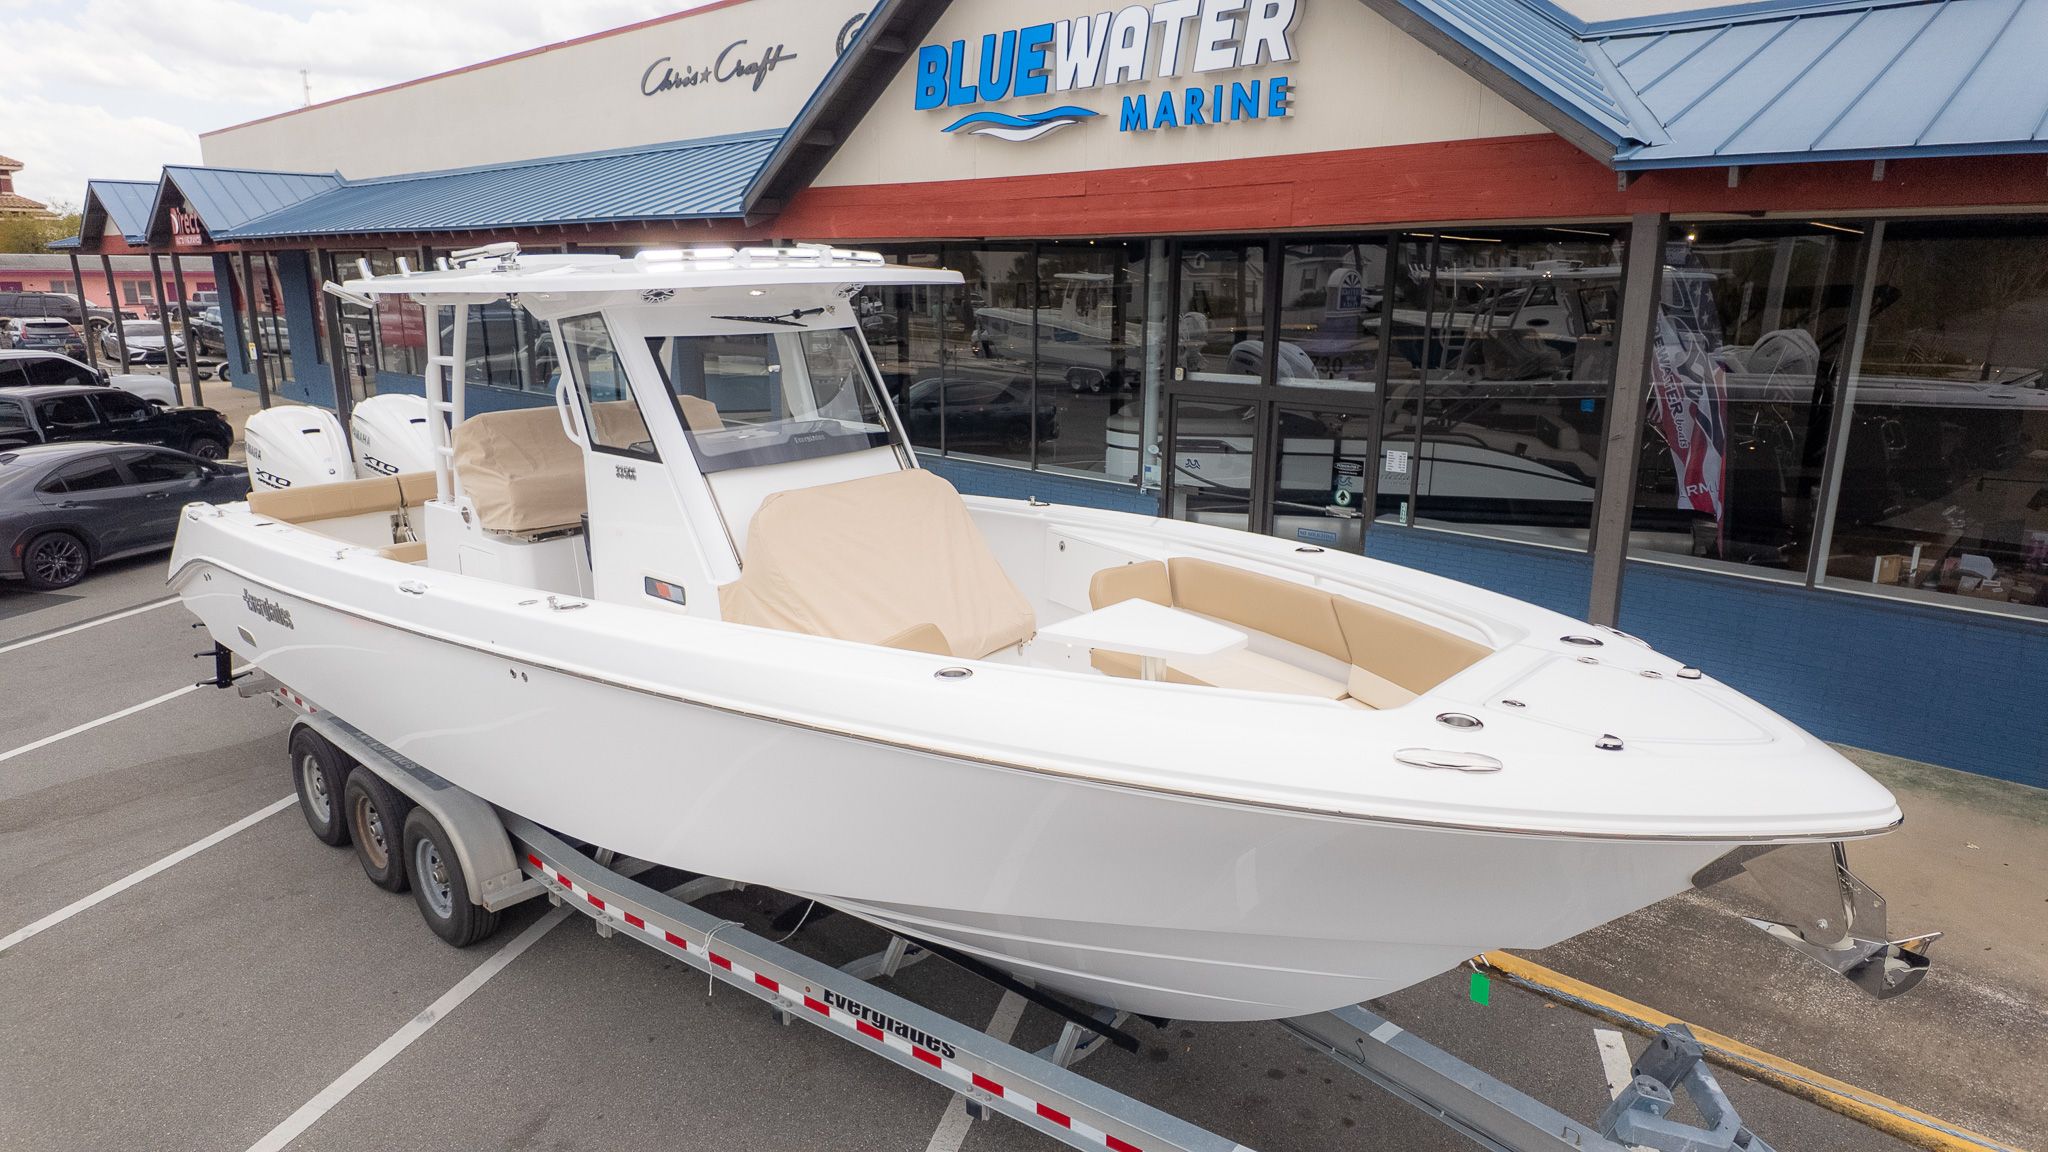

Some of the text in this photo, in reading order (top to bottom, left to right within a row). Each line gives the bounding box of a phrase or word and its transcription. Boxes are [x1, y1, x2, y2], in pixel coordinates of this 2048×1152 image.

[641, 39, 797, 97] Chris Craft
[914, 0, 1299, 110] BLUEWATER
[1120, 76, 1289, 132] MARINE
[255, 467, 291, 487] XTO
[363, 453, 399, 474] XTO
[242, 588, 294, 630] Everglades
